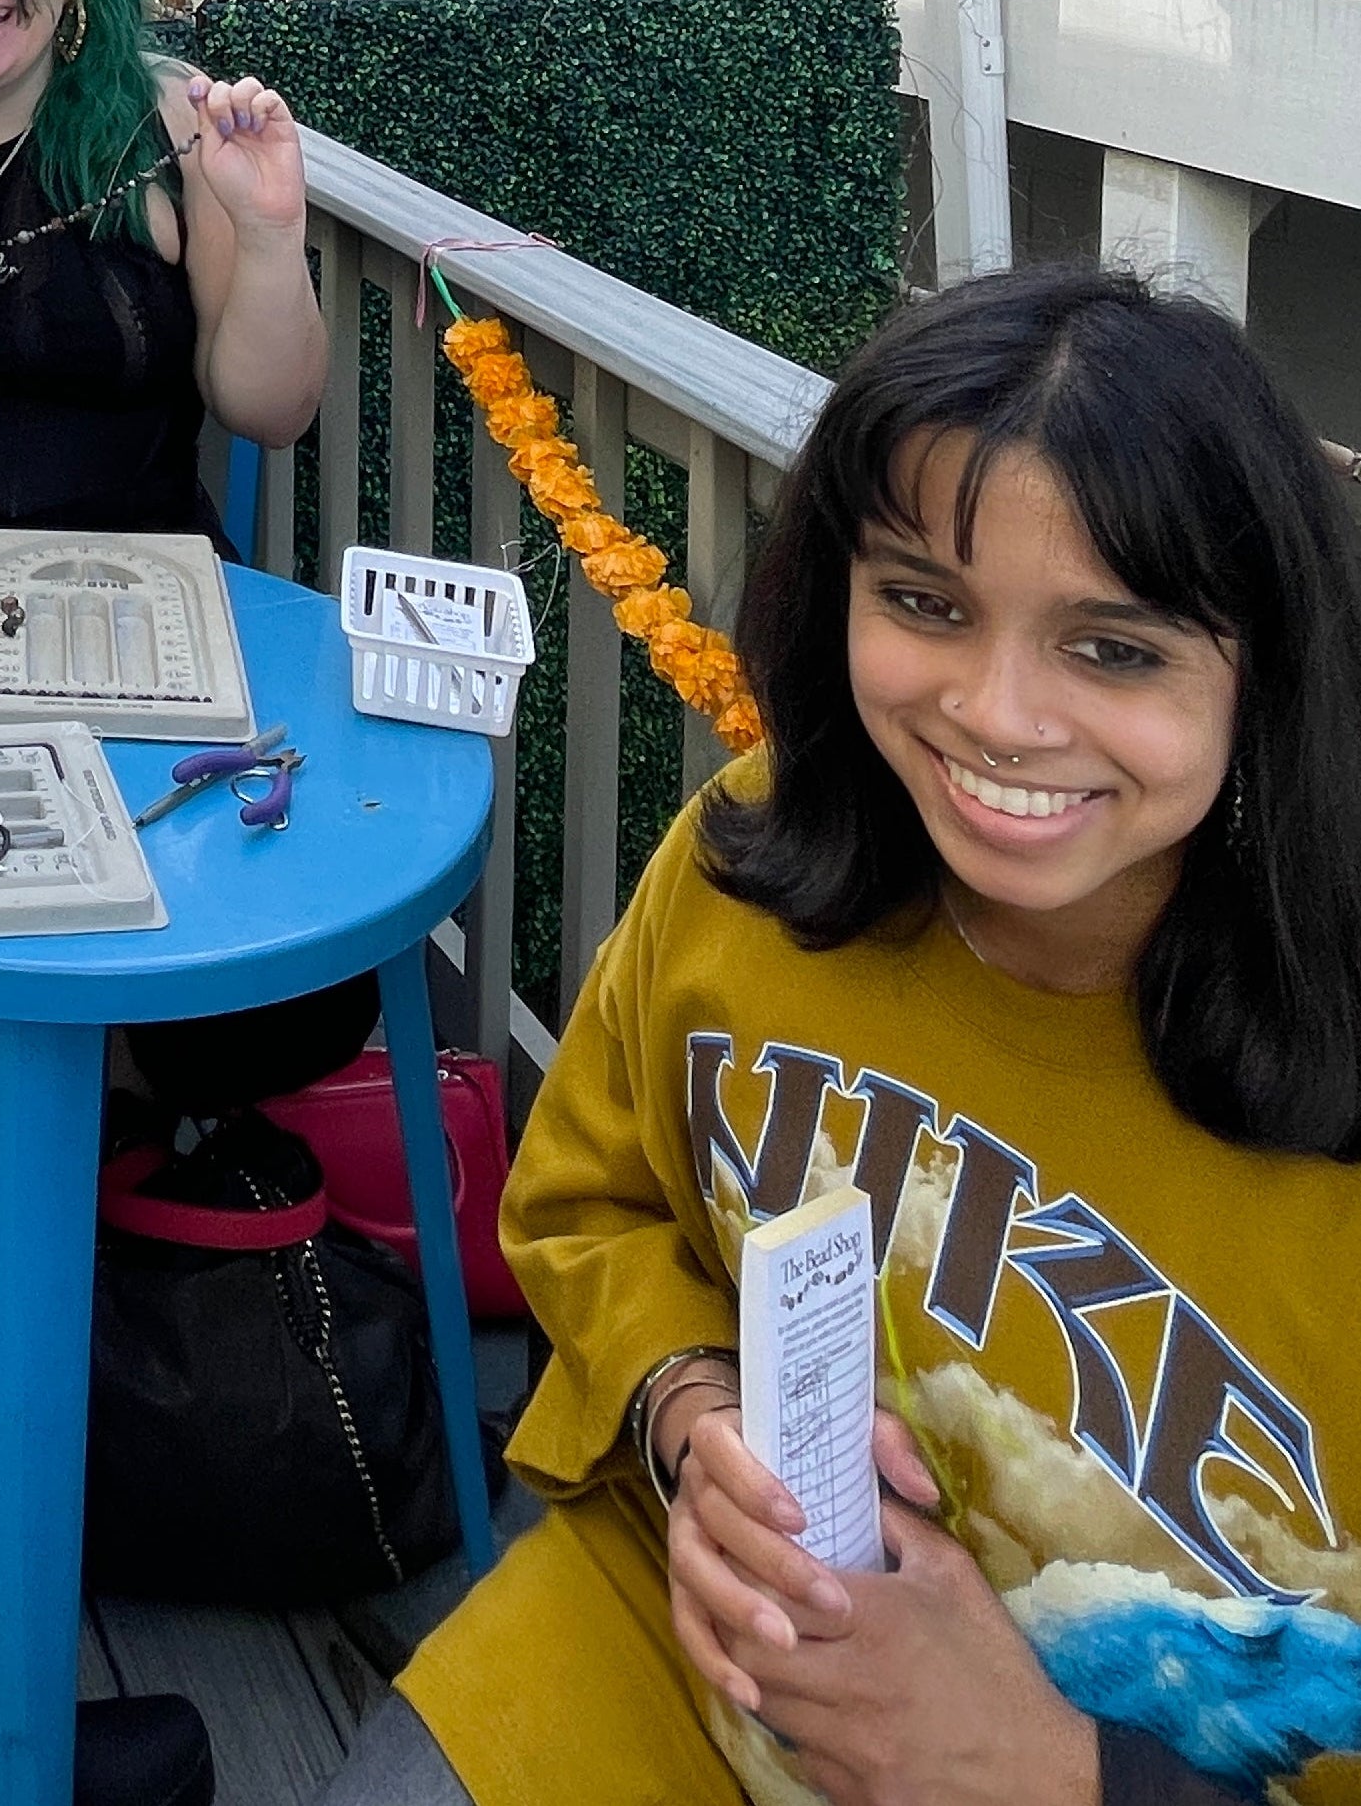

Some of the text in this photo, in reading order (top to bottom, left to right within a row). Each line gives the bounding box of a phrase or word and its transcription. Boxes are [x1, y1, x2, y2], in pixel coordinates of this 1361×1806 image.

[686, 1031, 1338, 1606] NIKE
[780, 1231, 862, 1285] The Bead Shop
